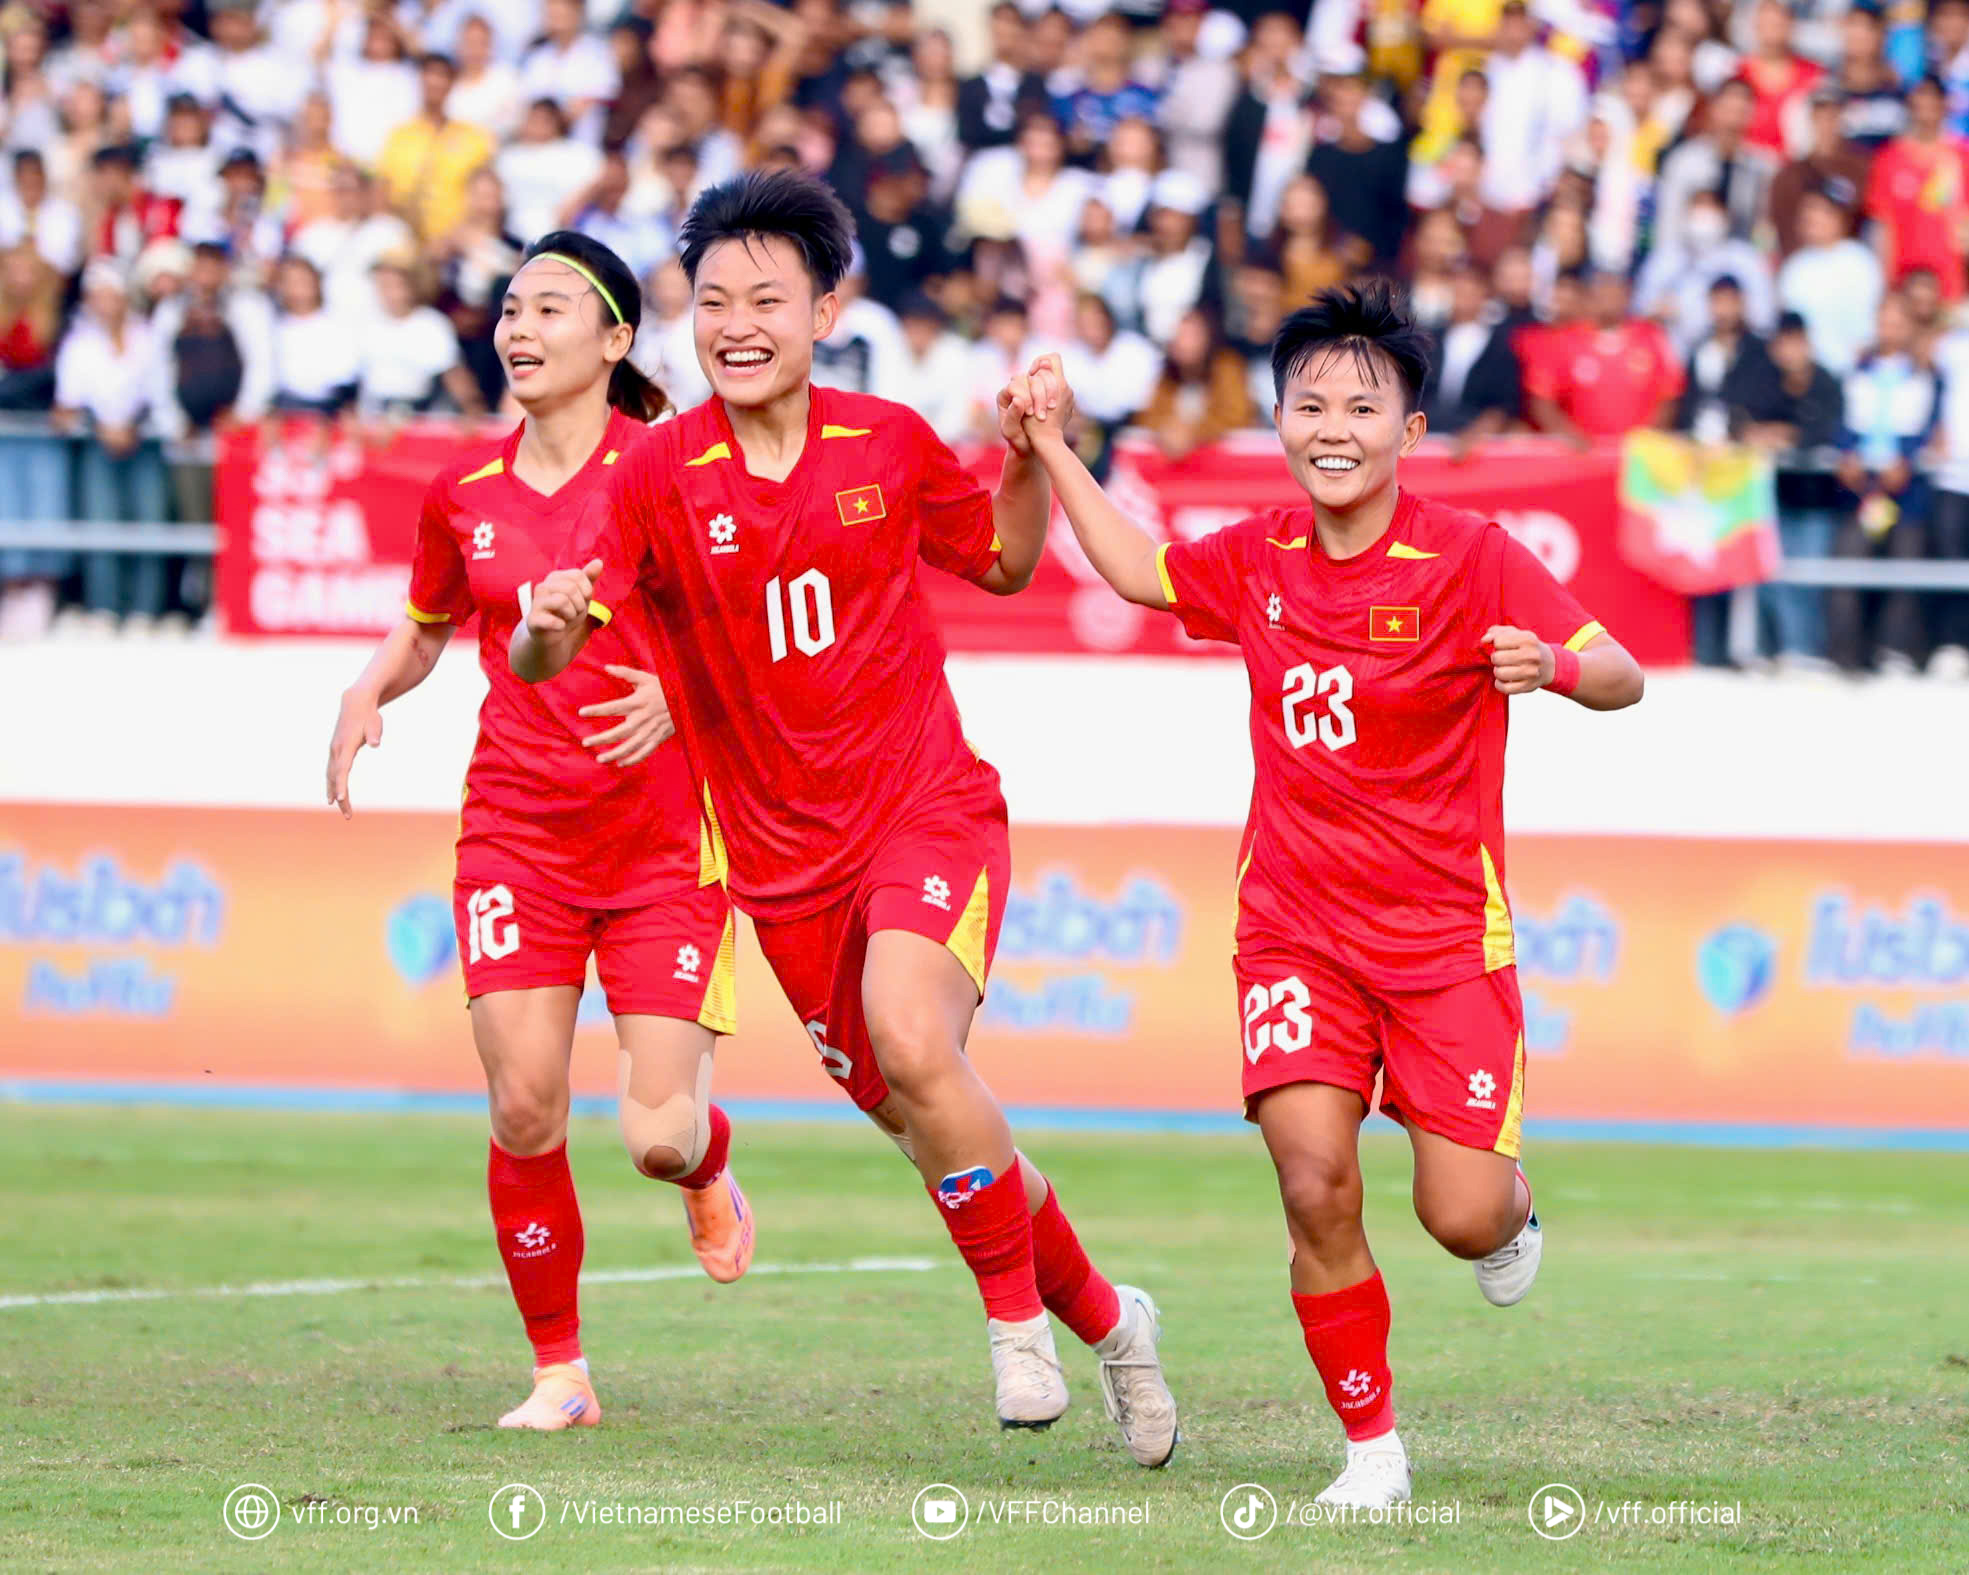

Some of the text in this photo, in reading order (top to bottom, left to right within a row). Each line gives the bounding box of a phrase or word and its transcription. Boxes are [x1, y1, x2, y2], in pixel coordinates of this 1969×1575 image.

[765, 567, 836, 663] 10
[1281, 662, 1357, 752] 23
[467, 884, 521, 965] 12
[1244, 975, 1313, 1065] 23
